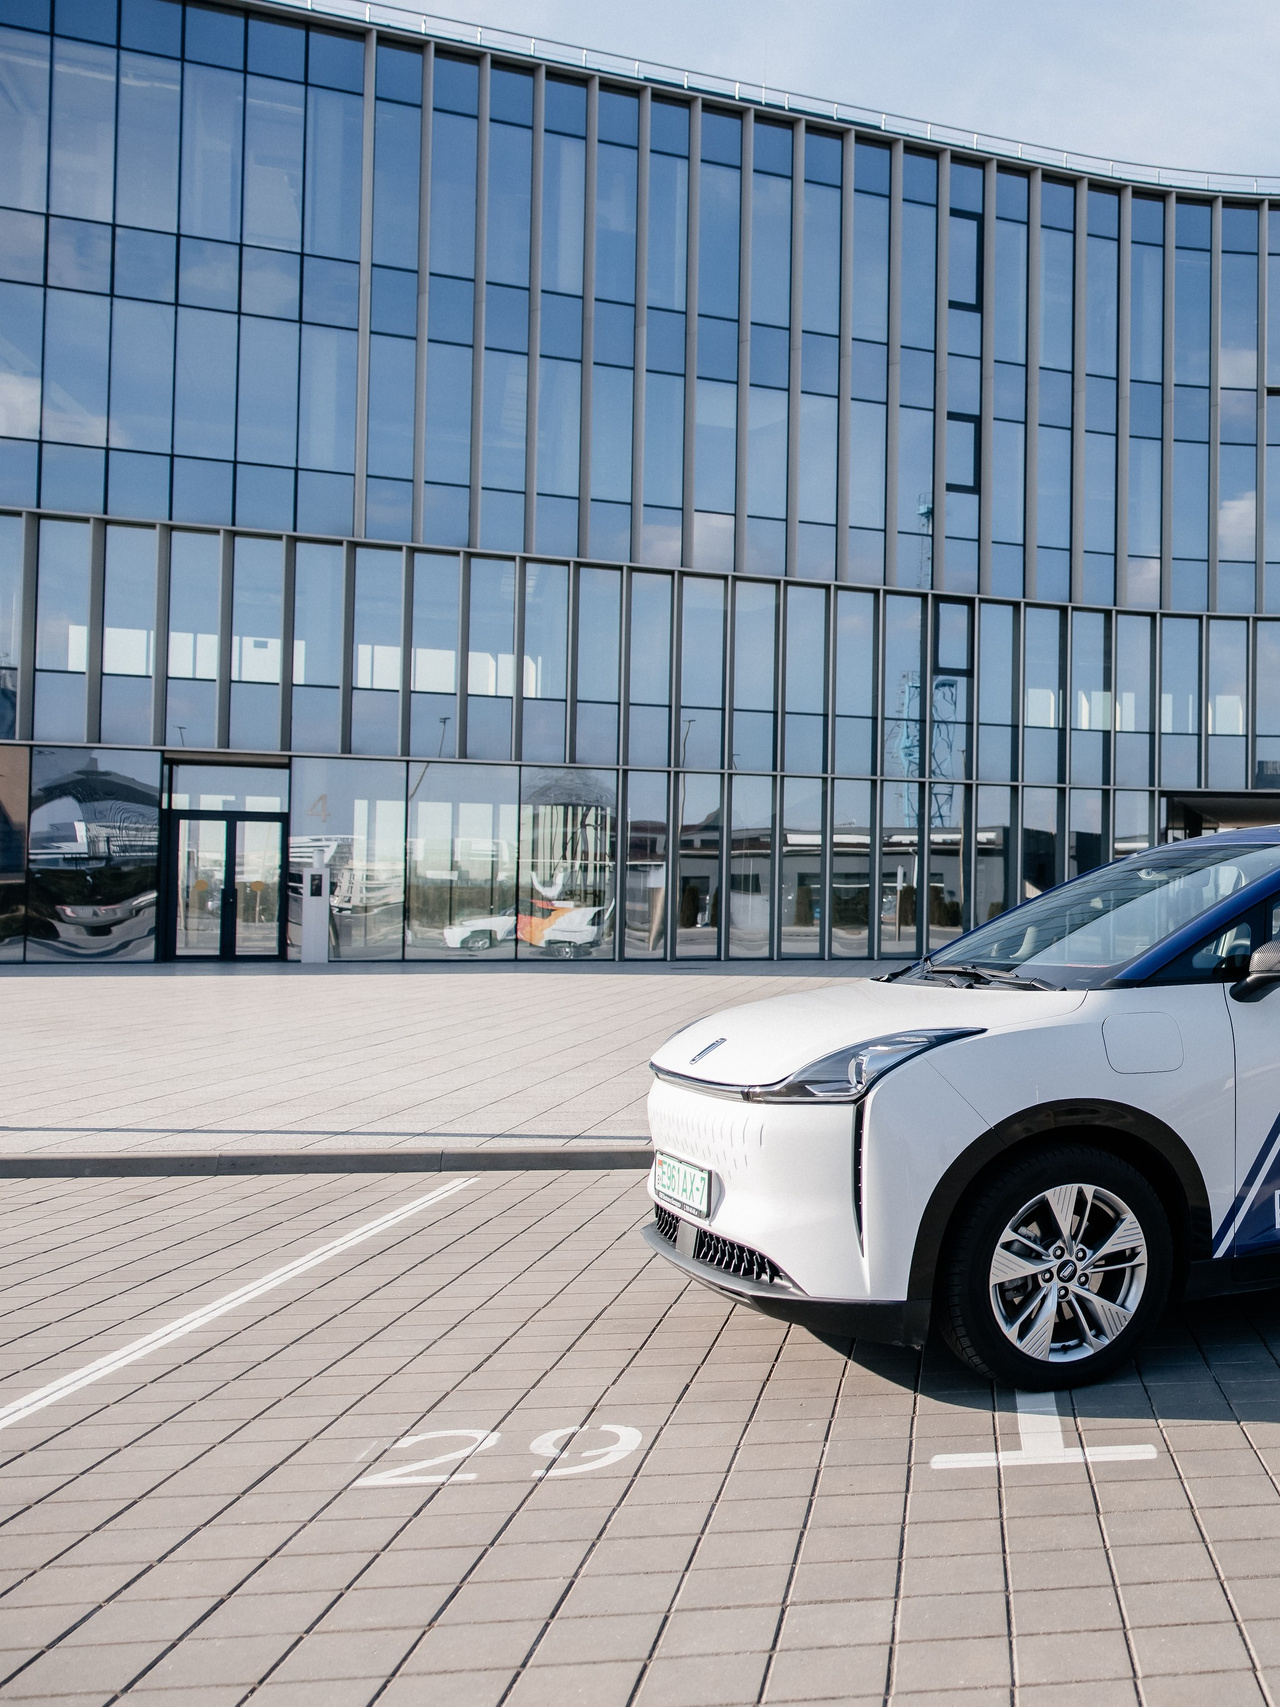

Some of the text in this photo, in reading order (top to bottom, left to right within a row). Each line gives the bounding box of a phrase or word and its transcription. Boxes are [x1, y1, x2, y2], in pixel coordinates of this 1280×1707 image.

[306, 793, 331, 823] 4
[661, 1159, 706, 1206] E961AX-7
[352, 1424, 643, 1486] 29
